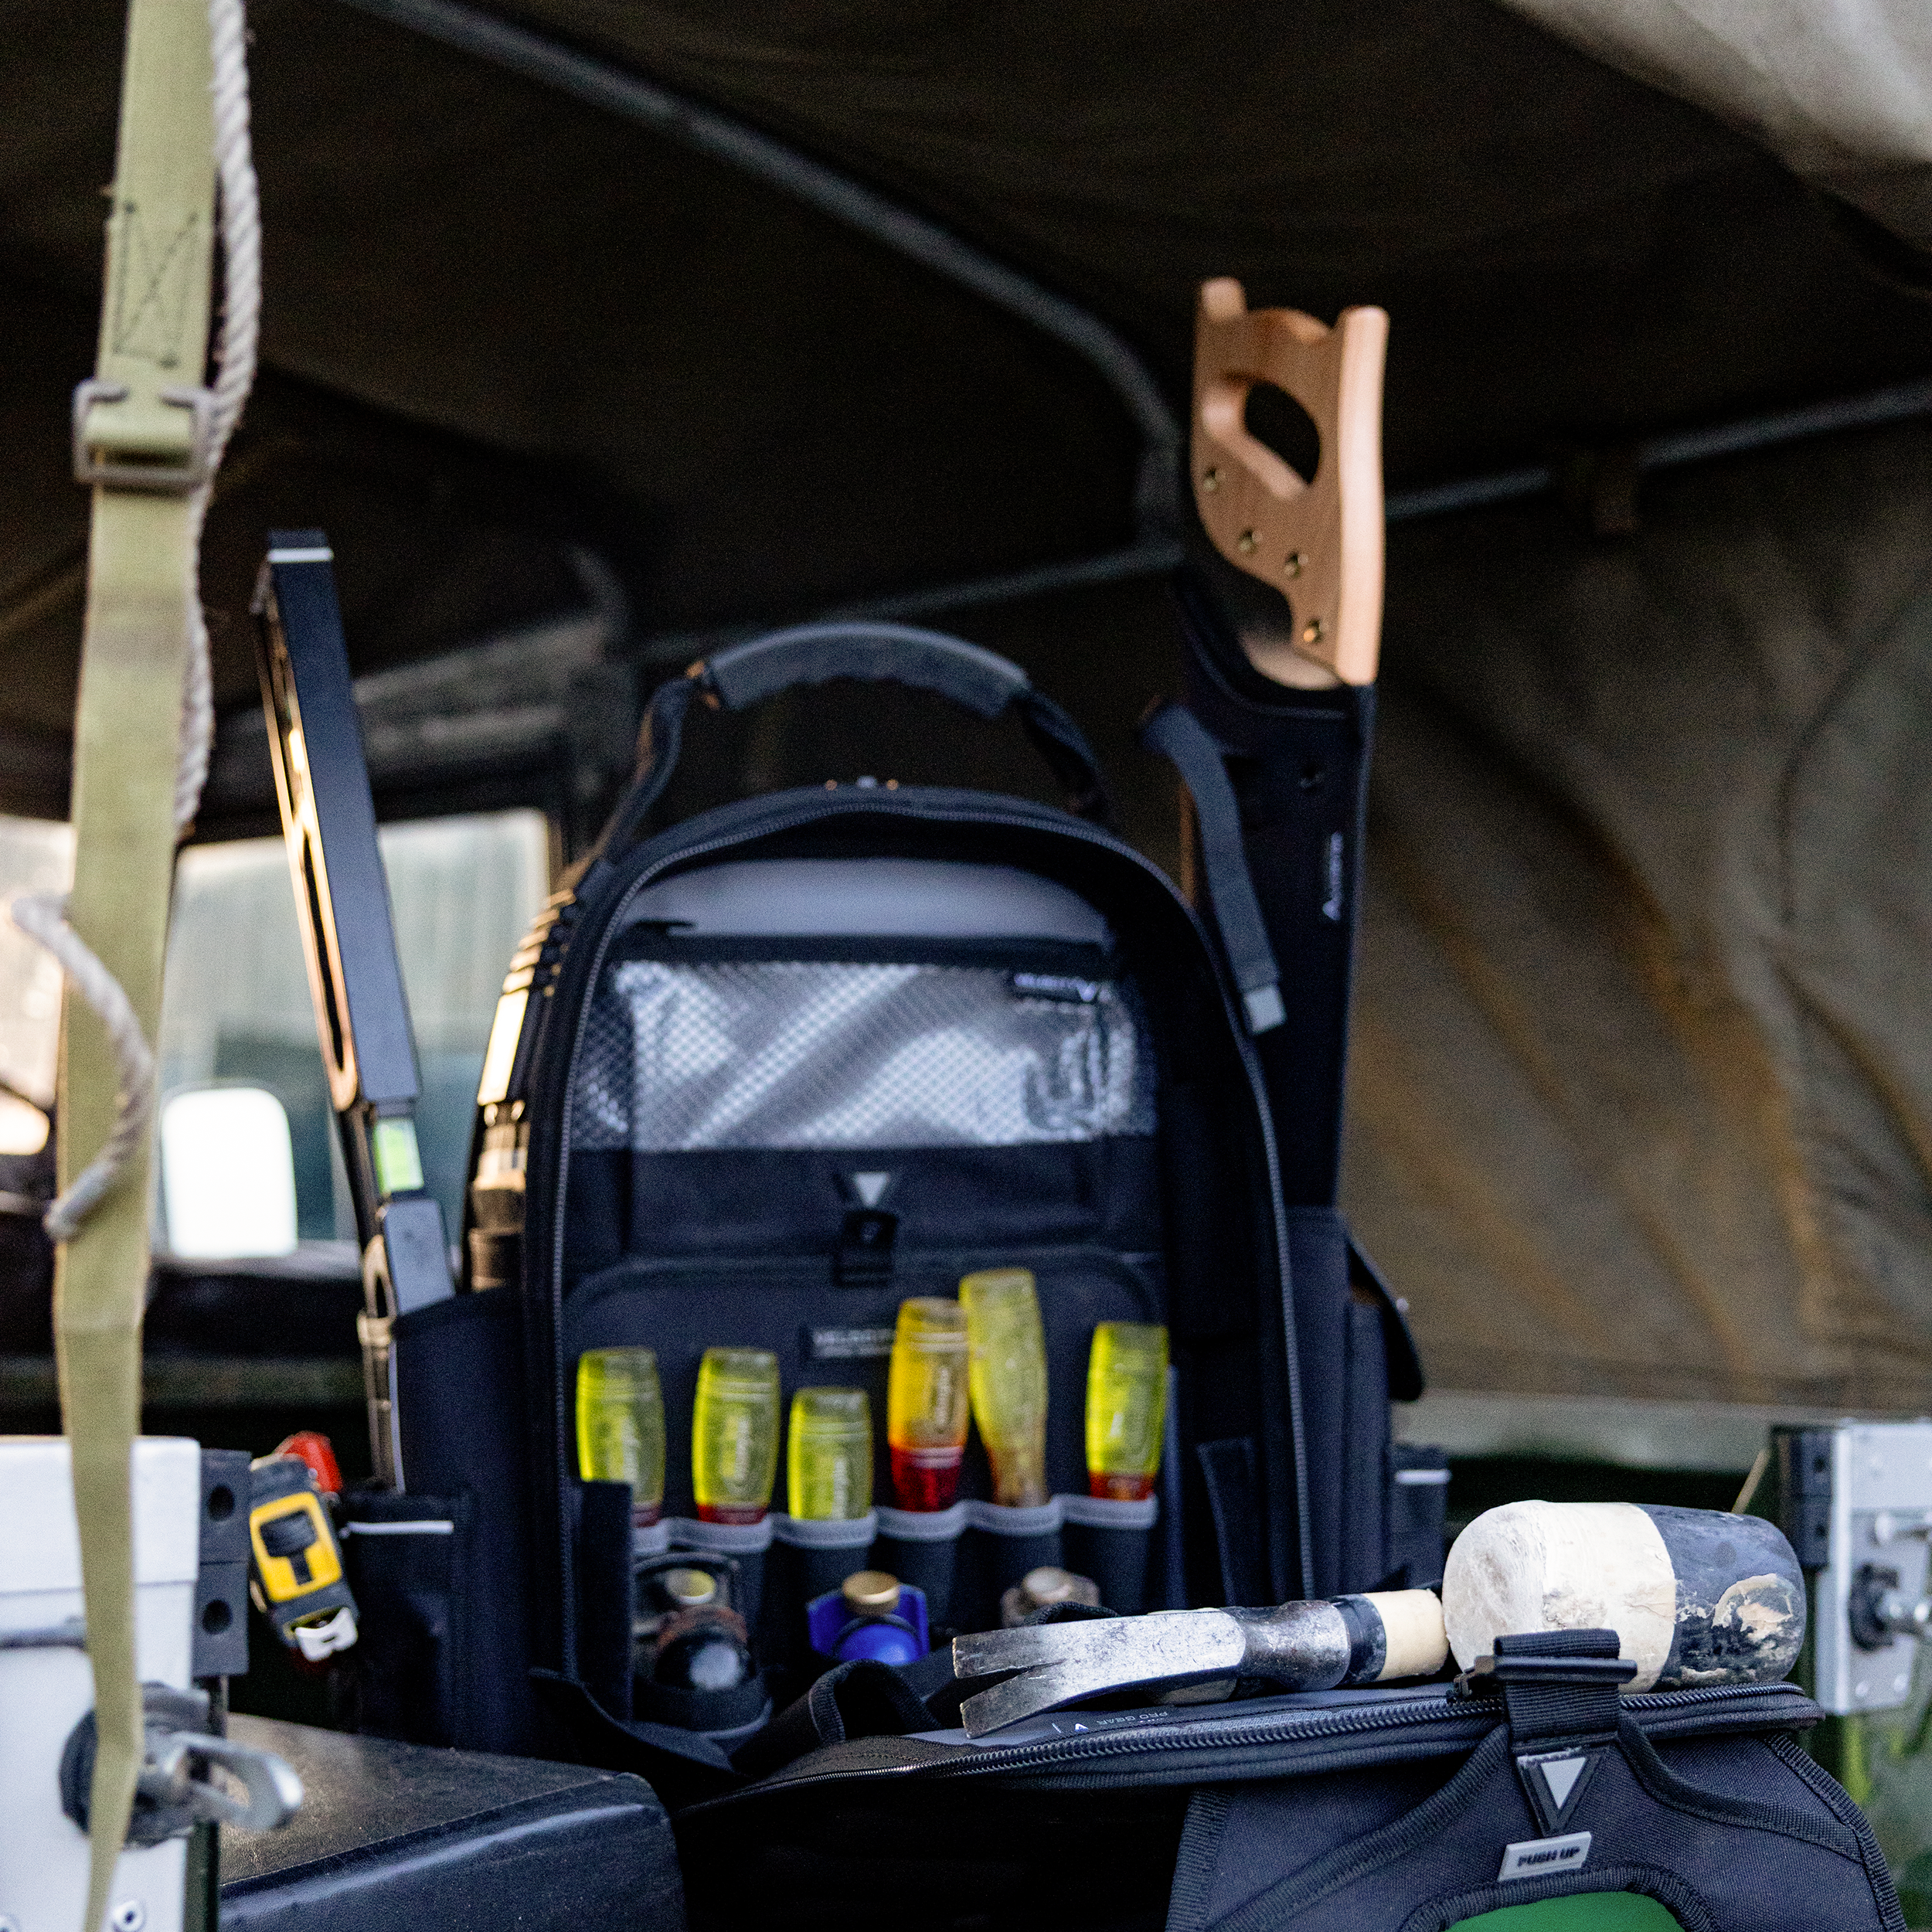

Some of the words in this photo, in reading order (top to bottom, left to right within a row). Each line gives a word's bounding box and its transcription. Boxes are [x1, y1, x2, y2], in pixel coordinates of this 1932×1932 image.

[1139, 1711, 1168, 1719] PRO
[1097, 1716, 1136, 1725] GEAR
[1518, 1849, 1558, 1867] PUSH
[1560, 1846, 1580, 1859] UP
